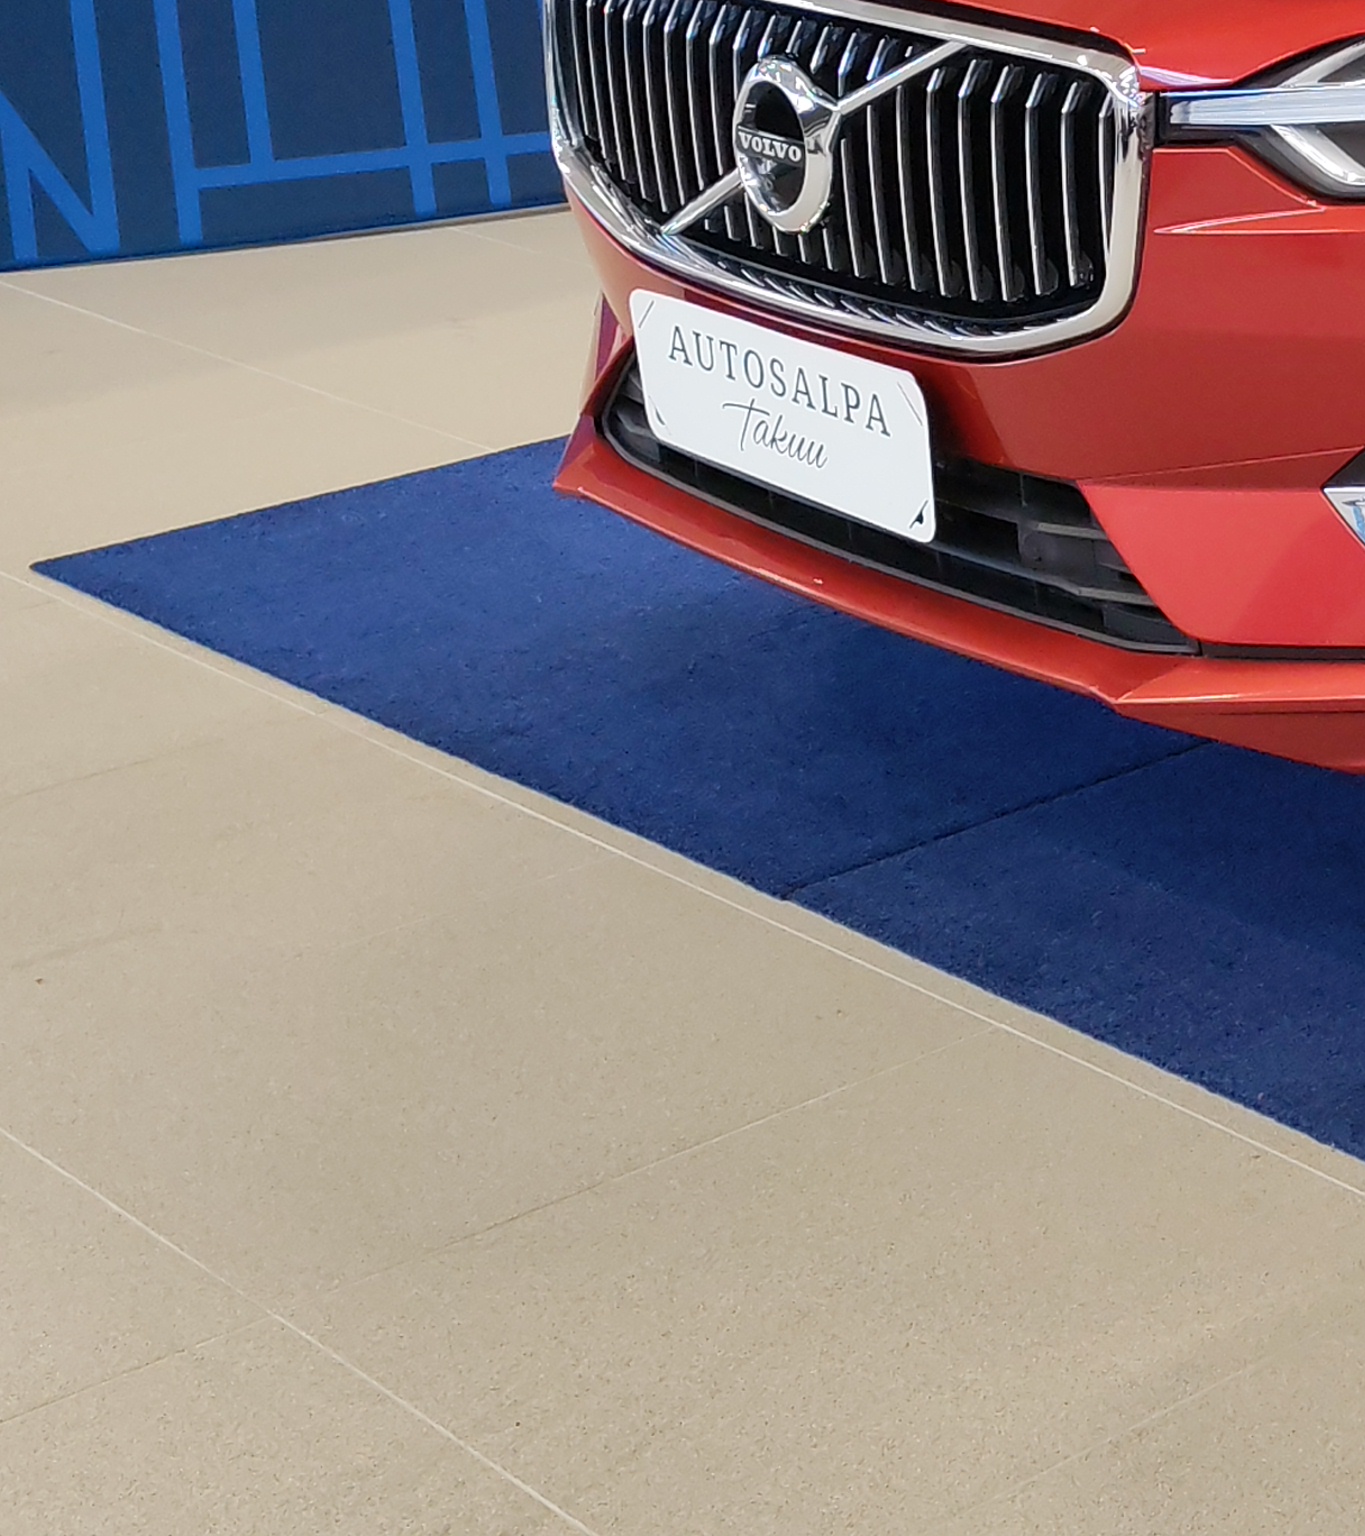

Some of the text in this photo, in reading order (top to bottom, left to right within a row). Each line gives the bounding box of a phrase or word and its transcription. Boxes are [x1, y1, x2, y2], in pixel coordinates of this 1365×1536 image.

[738, 130, 802, 162] VOLVO
[668, 324, 892, 438] AUTOSALPA
[722, 398, 828, 469] Takuu
